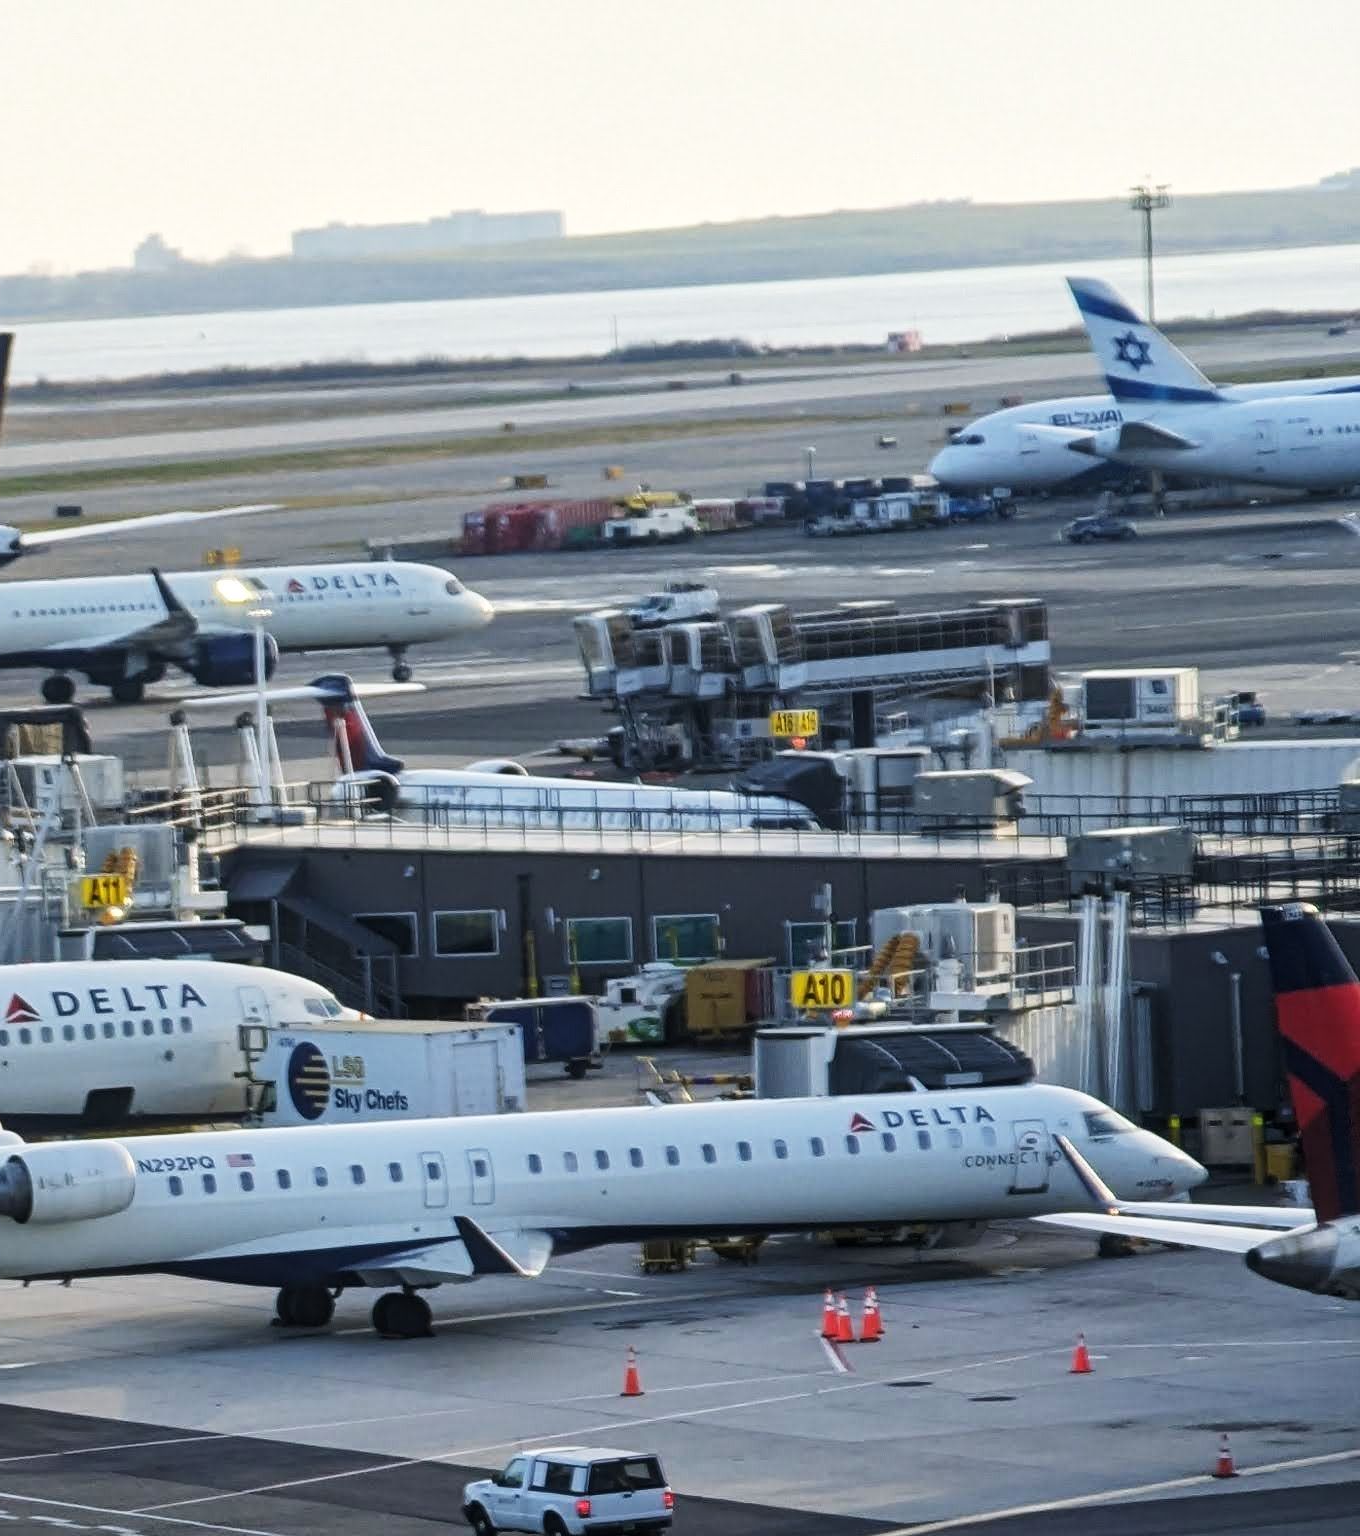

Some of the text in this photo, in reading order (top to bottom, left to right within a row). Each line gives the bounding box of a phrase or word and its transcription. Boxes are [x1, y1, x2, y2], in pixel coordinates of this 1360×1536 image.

[311, 571, 400, 590] DELTA
[89, 877, 120, 905] A11
[52, 983, 208, 1017] DELTA
[803, 973, 845, 1004] A10
[335, 1087, 409, 1112] Sky Chefs
[882, 1104, 996, 1129] DELTA
[137, 1155, 216, 1173] N292PQ
[964, 1150, 1070, 1168] CONNECTIO
